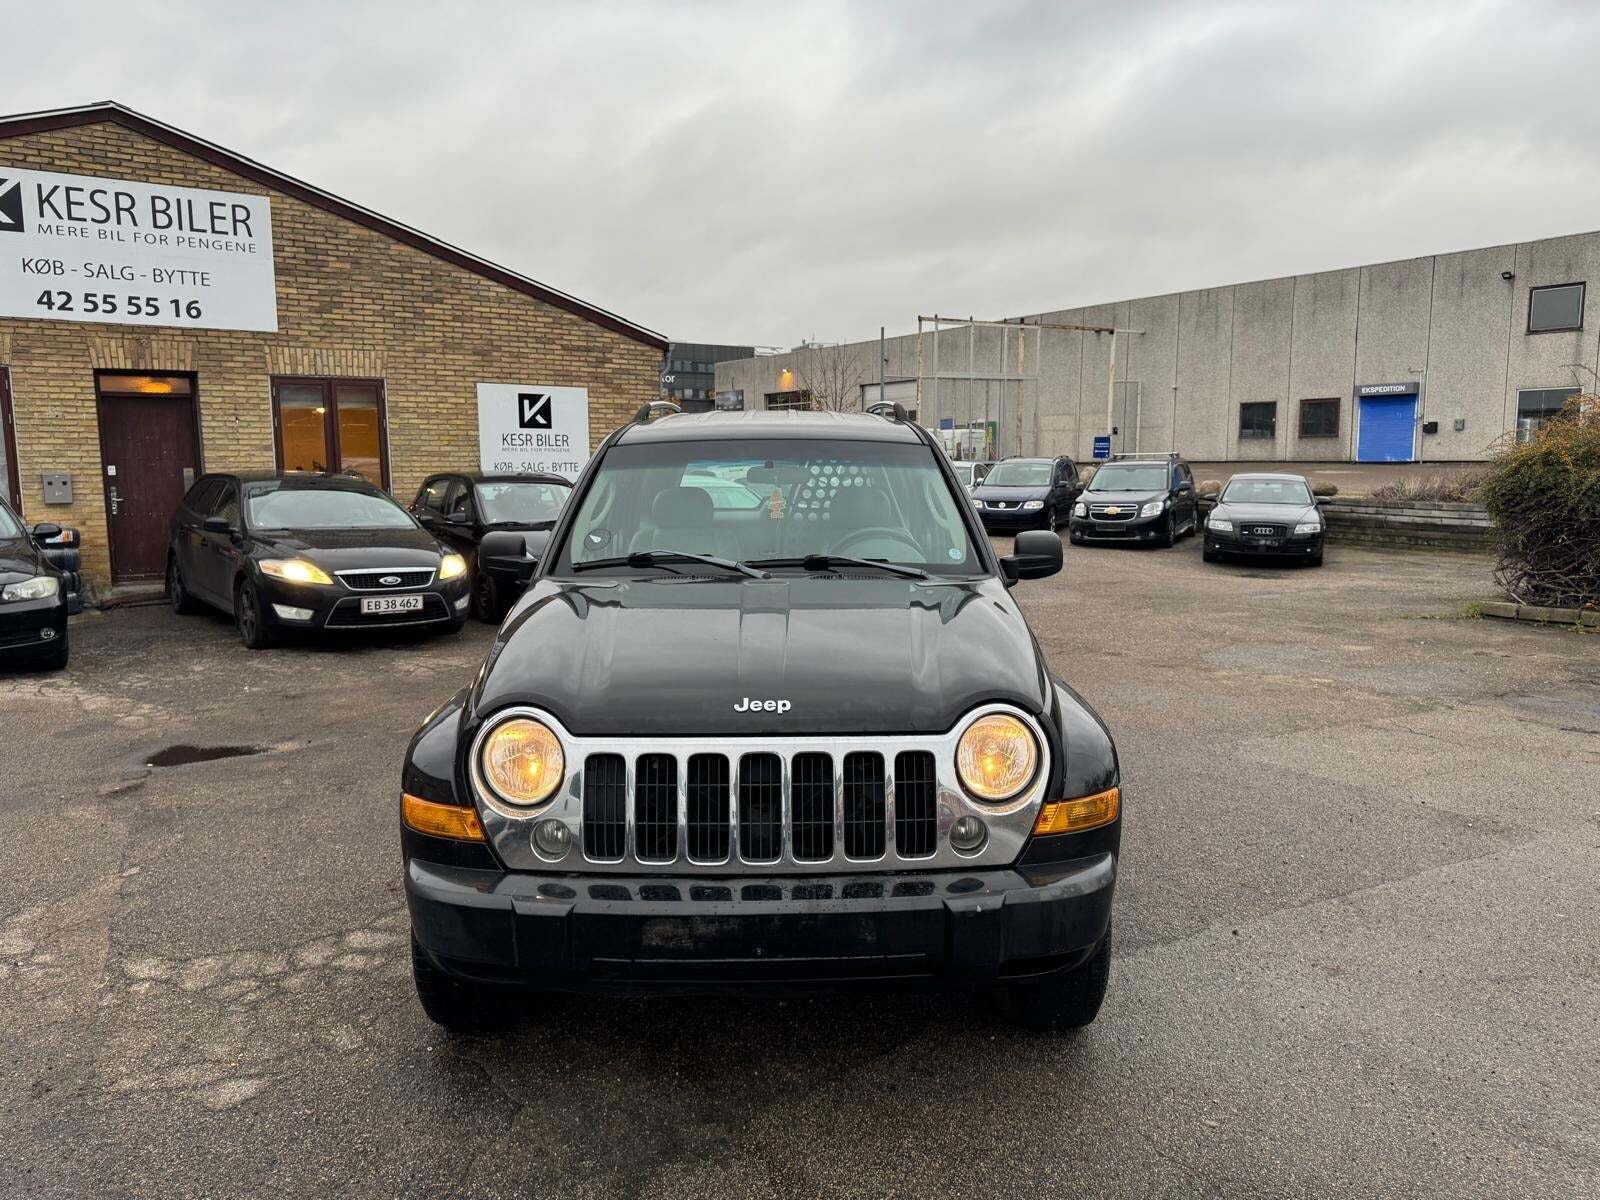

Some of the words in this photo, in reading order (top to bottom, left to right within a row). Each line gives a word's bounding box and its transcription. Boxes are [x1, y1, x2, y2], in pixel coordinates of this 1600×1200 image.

[37, 183, 138, 227] KESR
[150, 195, 253, 238] BILER
[37, 223, 89, 239] MERE
[98, 229, 126, 242] BIL
[133, 232, 169, 246] FOR
[176, 236, 256, 254] PENGENE
[21, 257, 65, 276] KØB
[83, 262, 135, 282] SALG
[152, 268, 212, 287] BYTTE
[36, 290, 74, 312] 42
[83, 292, 118, 314] 55
[127, 295, 160, 317] 55
[169, 299, 202, 319] 16
[1361, 385, 1406, 394] EKSPEDITION
[501, 433, 533, 447] KESR
[536, 433, 570, 447] BILER
[521, 462, 545, 472] SALG
[551, 462, 580, 473] BYTTE
[367, 601, 381, 611] EB
[383, 600, 397, 610] 38
[399, 598, 419, 609] 462
[733, 697, 792, 714] Jeep
